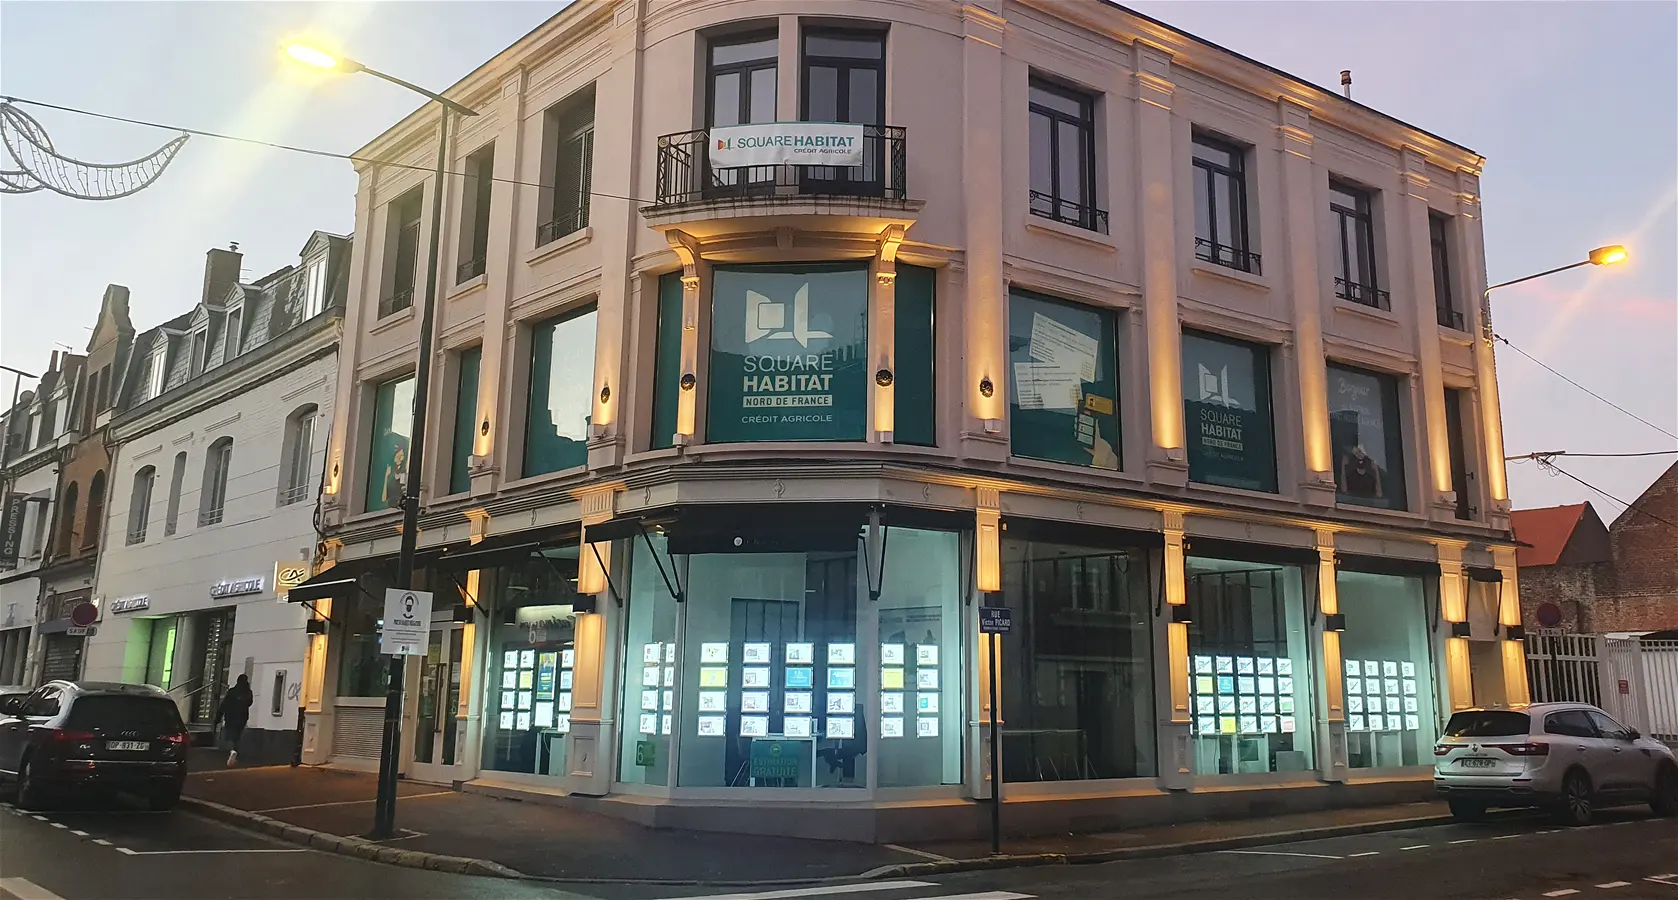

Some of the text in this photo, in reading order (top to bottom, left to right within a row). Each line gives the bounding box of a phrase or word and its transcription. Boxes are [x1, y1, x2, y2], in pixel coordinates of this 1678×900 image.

[743, 354, 833, 372] SQUARE
[743, 374, 833, 392] HABITAT
[746, 396, 829, 406] NORD DE FRANCE
[741, 414, 833, 424] CRÉDIT AGRICOLE
[1200, 408, 1243, 428] SQUARE
[1201, 422, 1242, 440] HABITAT
[3, 498, 20, 555] PRESSING
[991, 610, 1001, 618] RUE
[981, 618, 1011, 626] Victor PICARD
[754, 766, 797, 776] GRATUITE
